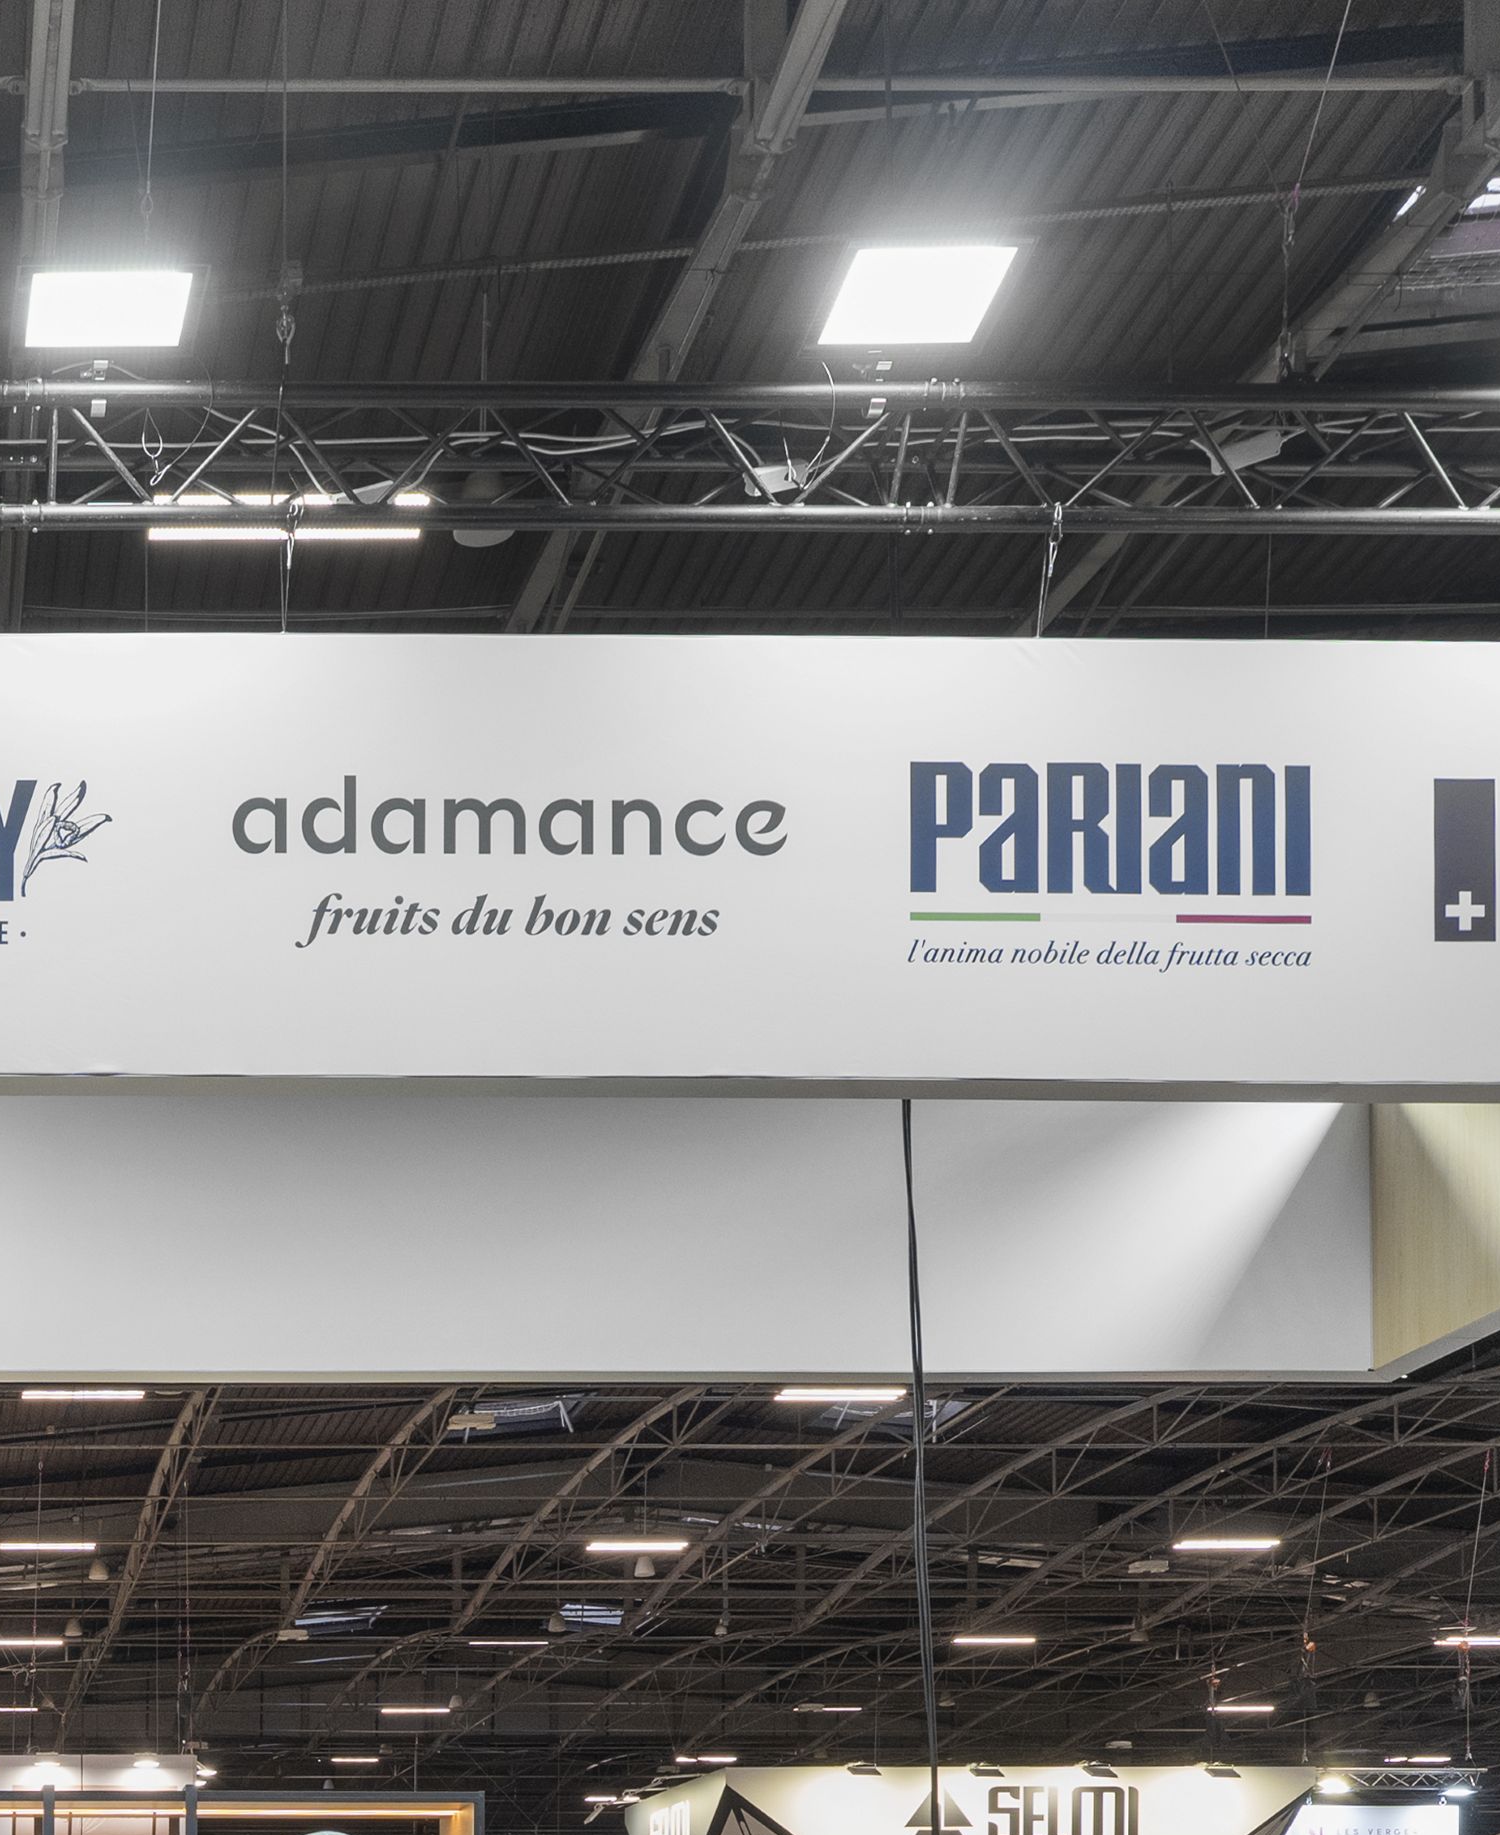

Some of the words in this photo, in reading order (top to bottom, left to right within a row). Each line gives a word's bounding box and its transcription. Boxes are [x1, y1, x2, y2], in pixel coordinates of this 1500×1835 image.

[232, 775, 788, 856] adamance
[295, 893, 441, 949] fruits
[452, 894, 513, 936] du
[525, 894, 612, 937] bon
[623, 908, 720, 937] sens
[907, 939, 1004, 965] l'anima
[1011, 941, 1090, 965] nobile
[1097, 941, 1160, 966] della
[1160, 942, 1239, 973] frutta
[1245, 949, 1312, 967] secca
[1337, 1828, 1359, 1835] LES
